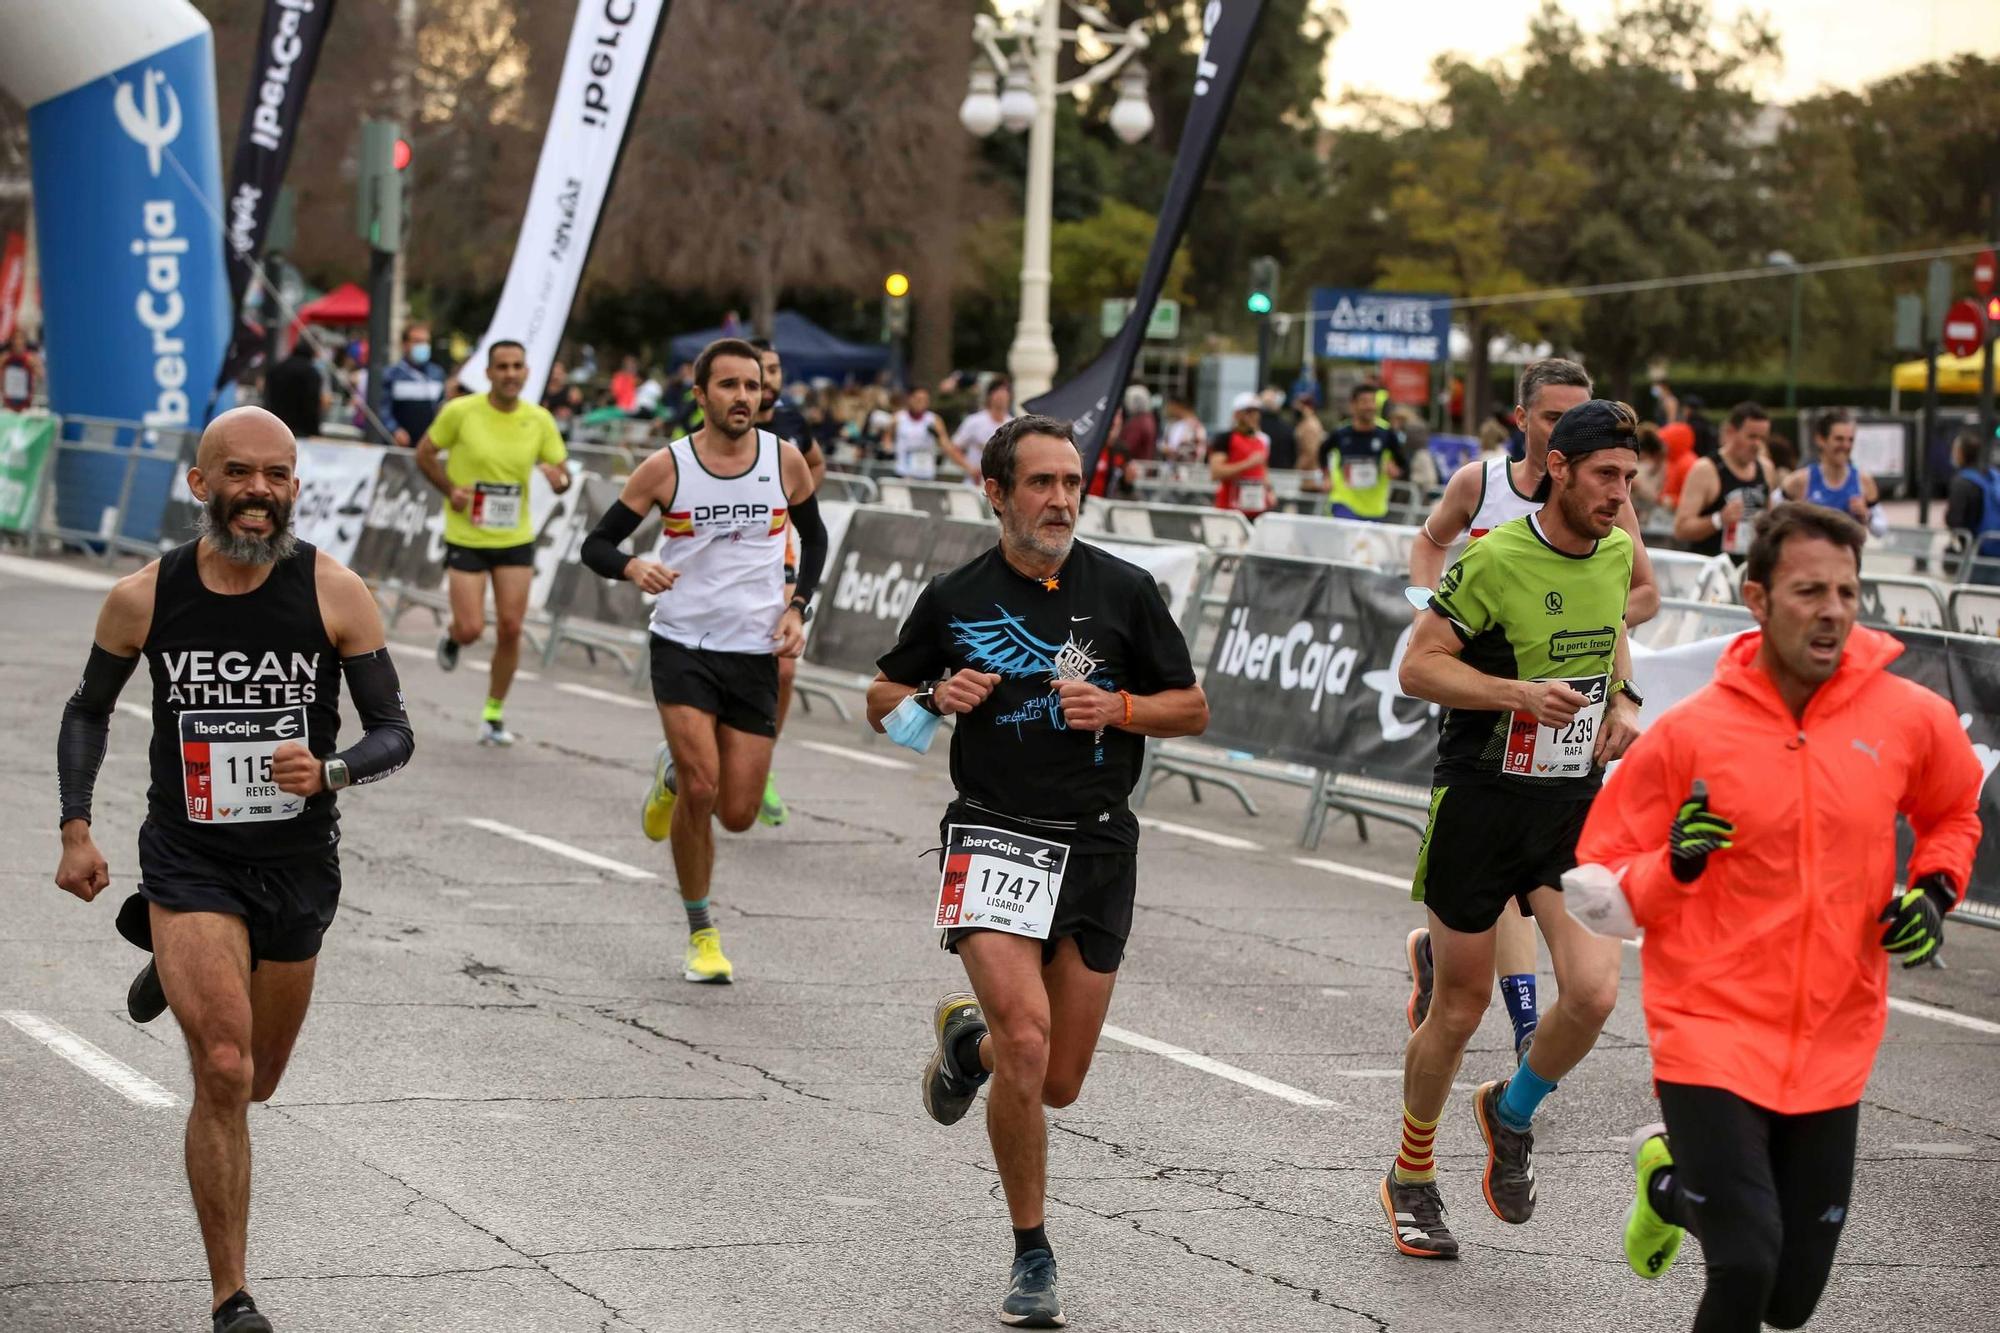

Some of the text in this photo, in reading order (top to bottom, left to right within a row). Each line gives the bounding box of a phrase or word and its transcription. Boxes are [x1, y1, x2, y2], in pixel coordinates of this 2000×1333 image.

[694, 504, 769, 520] DPAP
[1556, 639, 1612, 653] la porte fresca
[162, 650, 320, 683] VEGAN
[1060, 648, 1093, 675] 10K
[1217, 606, 1358, 713] iberCaja
[167, 682, 317, 705] ATHLETES
[194, 720, 260, 737] iberCaja
[1553, 717, 1593, 745] 1239
[1514, 752, 1530, 767] 01
[1564, 746, 1583, 756] RAFA
[246, 785, 277, 797] REYES
[194, 797, 208, 813] 01
[961, 835, 1021, 857] iberCaja
[980, 868, 1041, 904] 1747
[946, 904, 959, 919] 01
[986, 896, 1025, 914] LISARDO
[1517, 978, 1533, 1011] PAST
